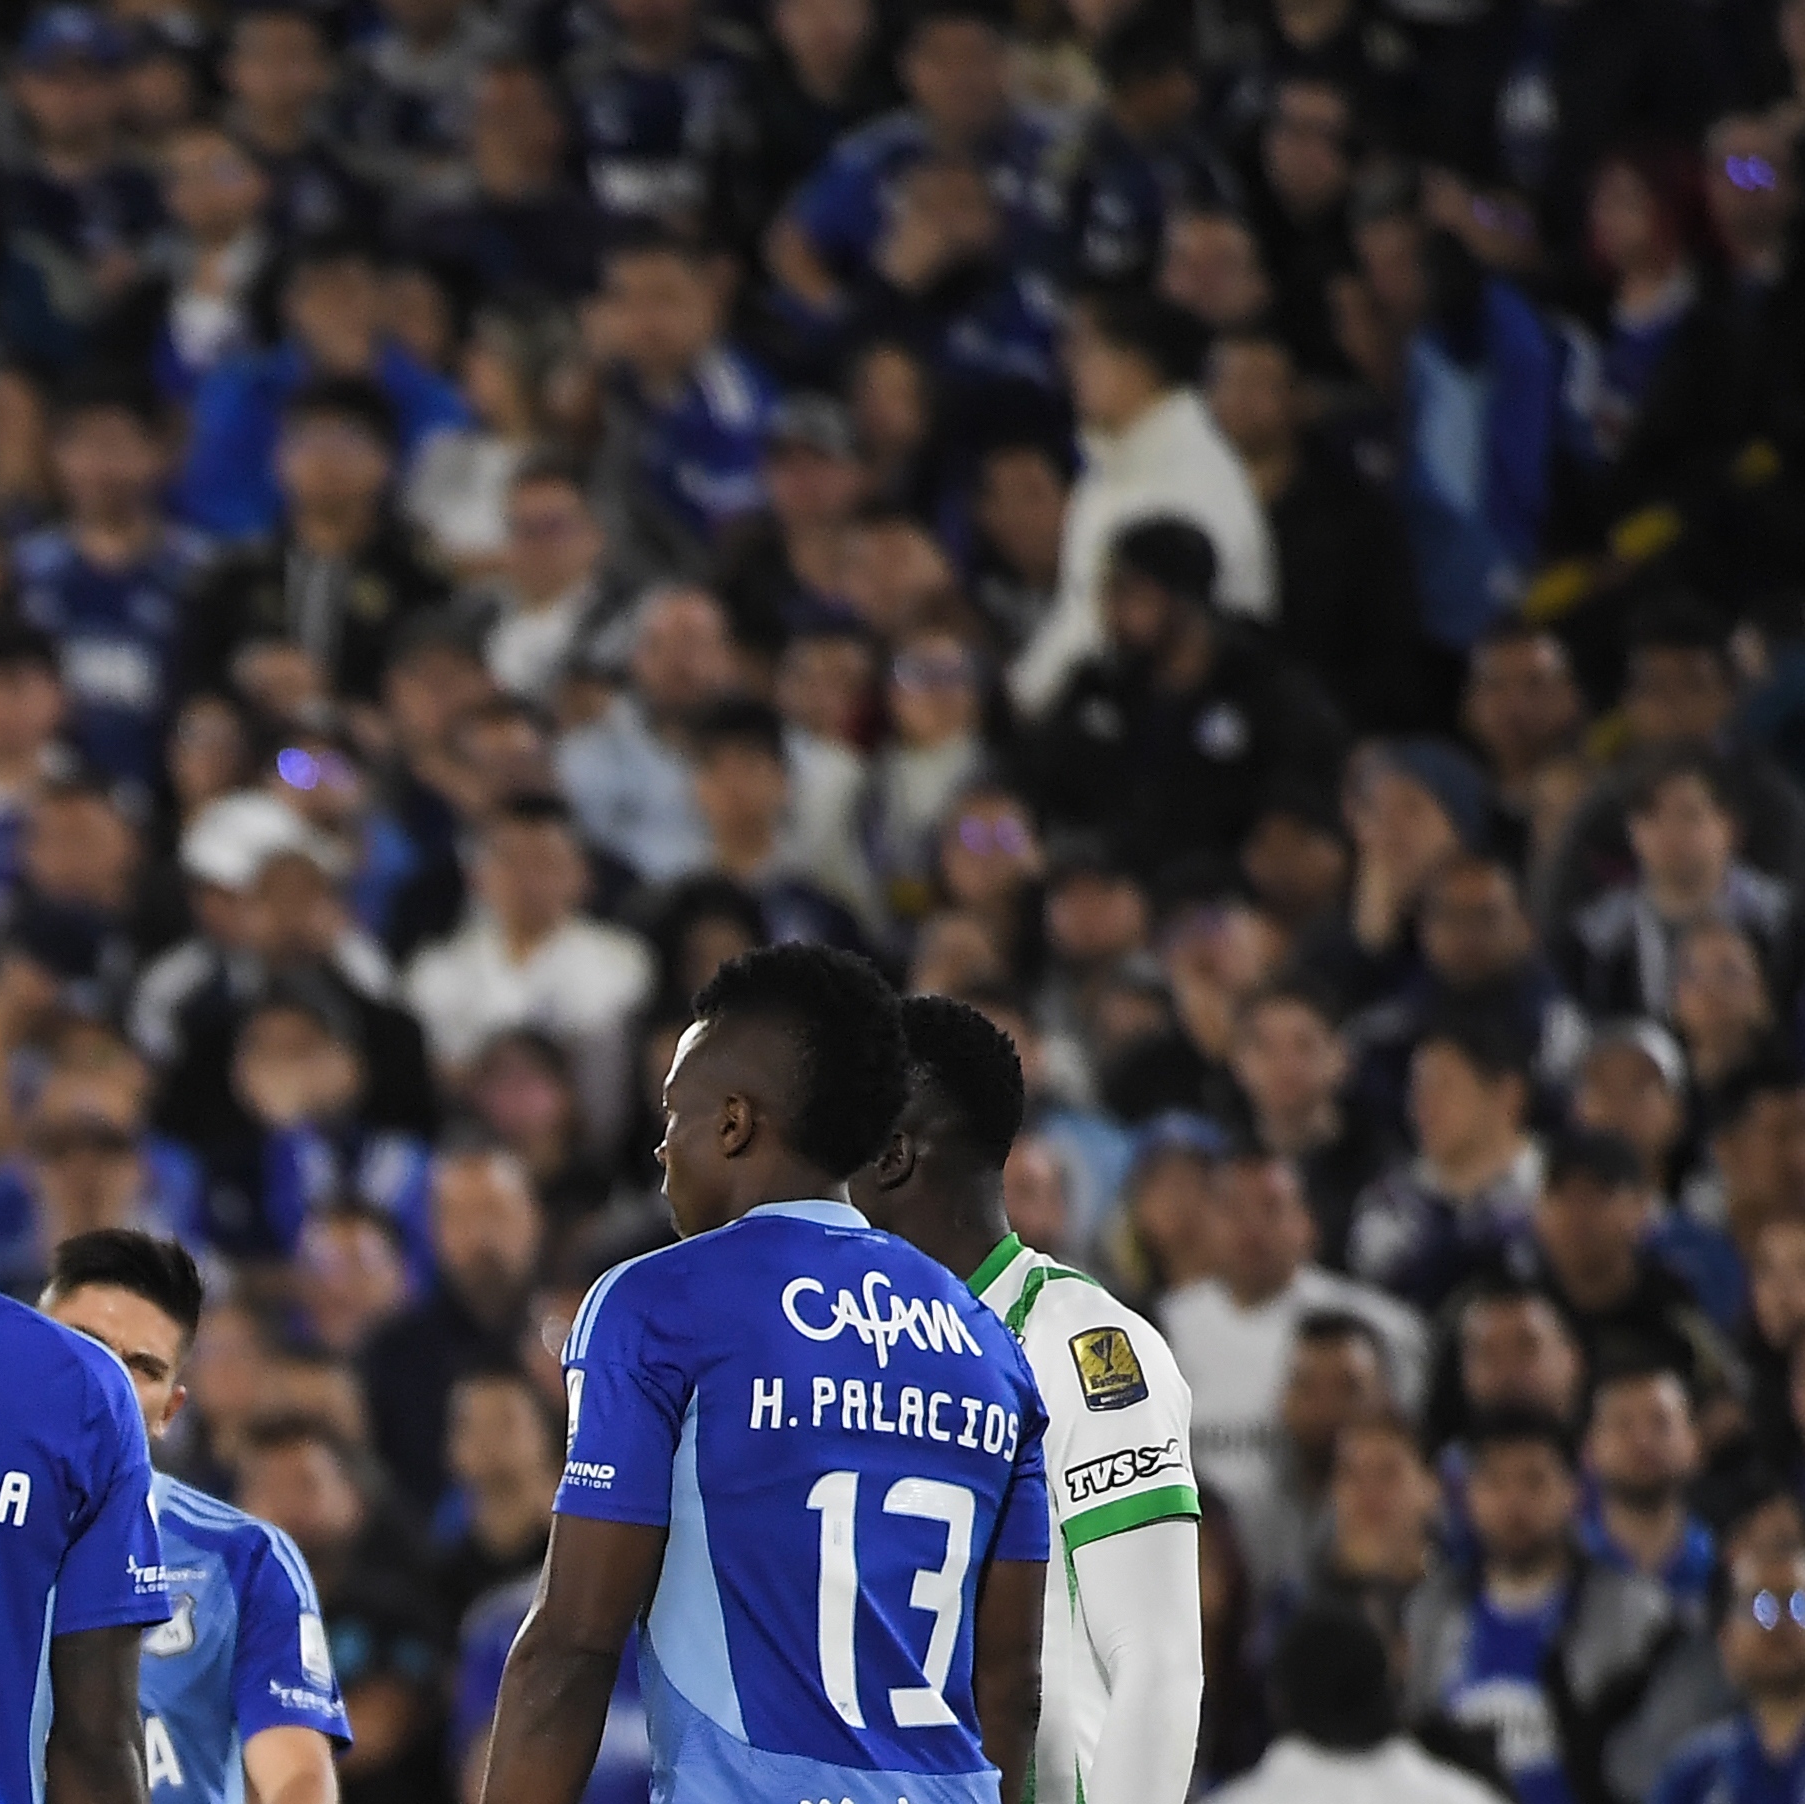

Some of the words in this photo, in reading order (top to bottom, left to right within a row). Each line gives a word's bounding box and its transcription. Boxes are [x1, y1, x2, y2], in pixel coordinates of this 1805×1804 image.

[750, 1378, 798, 1430] H.
[812, 1377, 1019, 1463] PALACIOS
[1065, 1452, 1136, 1502] TVS
[807, 1471, 976, 1729] 13
